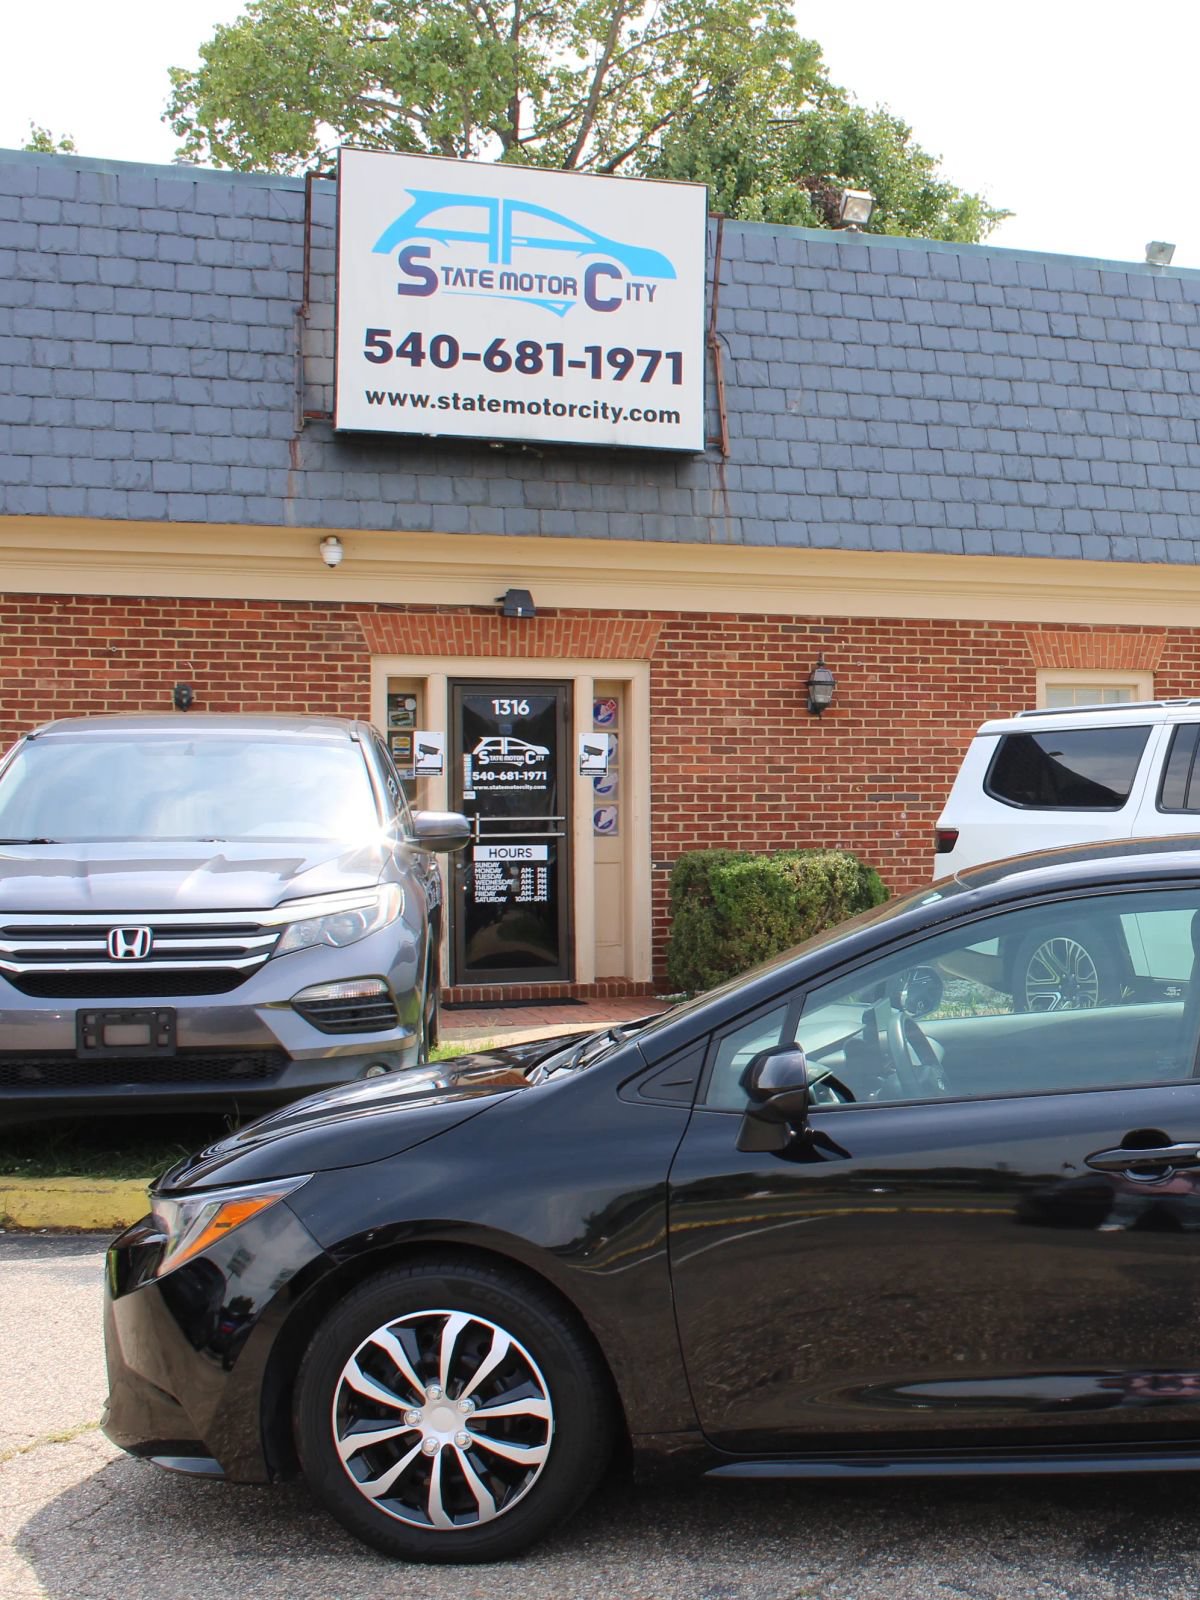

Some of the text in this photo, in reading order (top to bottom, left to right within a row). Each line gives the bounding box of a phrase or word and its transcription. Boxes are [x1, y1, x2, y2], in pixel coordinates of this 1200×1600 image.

[397, 245, 657, 313] STATE MOTOR CITY
[363, 328, 683, 385] 540-681-1971
[365, 389, 681, 424] www.statemotorcity.com
[491, 699, 530, 715] 1316
[472, 771, 547, 781] 540-681-1971
[488, 848, 533, 858] HOURS
